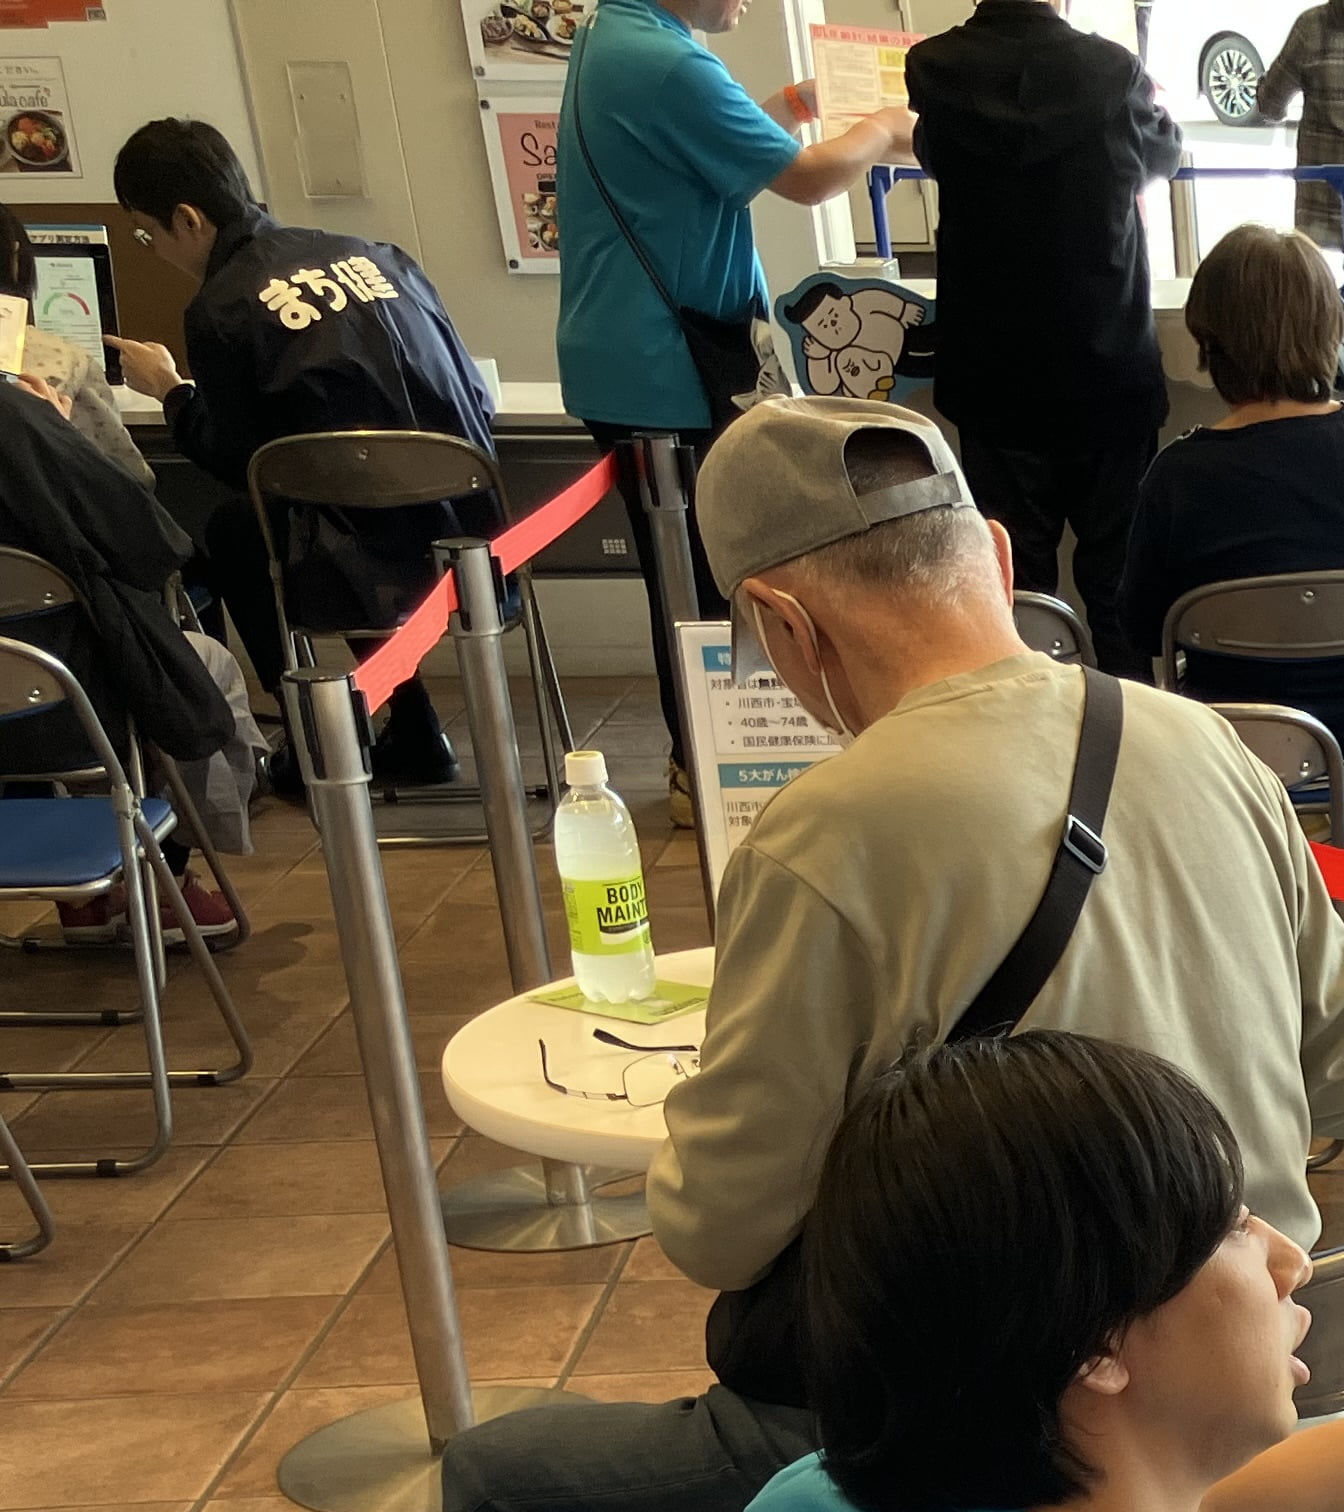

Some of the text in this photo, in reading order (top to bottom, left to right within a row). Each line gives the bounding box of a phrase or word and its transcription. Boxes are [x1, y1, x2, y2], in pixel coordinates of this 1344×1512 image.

[259, 256, 399, 330] まち健
[606, 881, 643, 905] BODY
